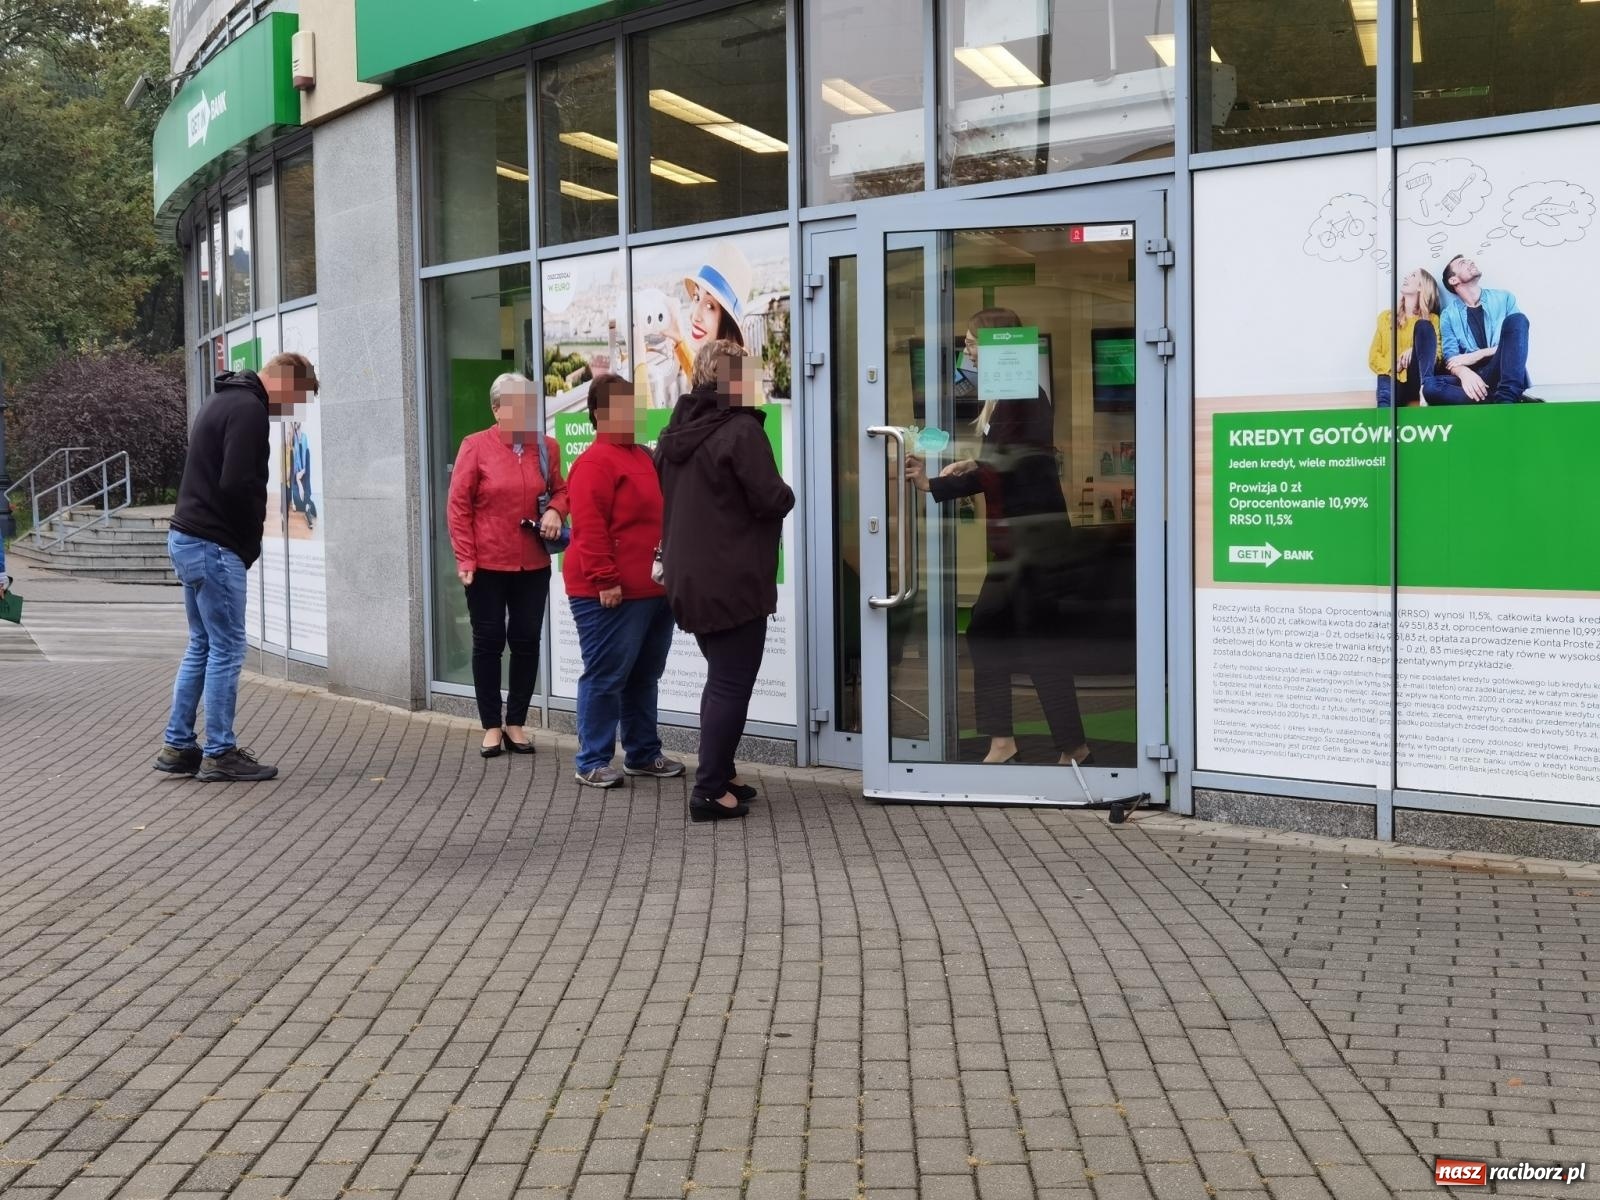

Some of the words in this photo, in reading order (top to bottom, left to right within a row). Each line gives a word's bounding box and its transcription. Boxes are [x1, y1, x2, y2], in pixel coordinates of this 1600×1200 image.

[210, 90, 227, 121] BANK
[554, 282, 571, 292] EURO
[1229, 428, 1305, 447] KREDYT
[1309, 422, 1453, 446] GOTÓWKOWY
[1229, 458, 1258, 469] Jeden
[1260, 458, 1296, 470] kredyt,
[1299, 457, 1326, 468] wiele
[1229, 482, 1278, 496] Prowizja
[1280, 482, 1288, 493] 0
[1290, 481, 1302, 493] zł
[1229, 497, 1326, 511] Oprocentowanie
[1328, 497, 1368, 510] 10,99%
[1229, 514, 1262, 526] RRSO
[1265, 514, 1294, 526] 11,5%
[1237, 550, 1258, 560] GET
[1261, 550, 1272, 560] IN
[1284, 550, 1314, 560] BANK
[1213, 602, 1261, 614] Rzeczywista
[1265, 604, 1294, 614] Roczna
[1298, 605, 1322, 617] Stopa
[1398, 608, 1429, 620] (RRSO)
[1434, 610, 1464, 621] wynosi
[1497, 612, 1542, 622] całkowita
[1546, 613, 1574, 623] kwota
[1213, 613, 1247, 626] kosztów)
[1249, 614, 1260, 624] 34
[1261, 615, 1275, 624] 600
[1288, 616, 1327, 626] całkowita
[1329, 617, 1354, 627] kwota
[1355, 618, 1366, 628] do
[1398, 620, 1409, 629] 49
[1411, 620, 1438, 633] 551,83
[1453, 624, 1528, 634] oprocentowanie
[1530, 625, 1570, 636] zmienne
[1213, 624, 1220, 633] 14
[1222, 624, 1246, 636] 951,83
[1248, 625, 1254, 634] zł
[1256, 625, 1264, 637] (w
[1285, 627, 1319, 639] prowizja
[1326, 628, 1332, 638] 0
[1344, 629, 1374, 639] odsetki
[1429, 633, 1458, 644] opłata
[1472, 635, 1531, 646] prowadzenie
[1534, 637, 1560, 647] Konta
[1563, 638, 1594, 648] Proste
[1213, 636, 1255, 649] debetowej
[1257, 638, 1267, 647] do
[1270, 638, 1293, 648] Konta
[1304, 640, 1334, 650] okresie
[1336, 641, 1365, 651] trwania
[1406, 644, 1412, 653] 0
[1430, 645, 1442, 655] 83
[1444, 646, 1494, 659] miesięczne
[1497, 648, 1514, 660] raty
[1517, 649, 1546, 659] równe
[1213, 647, 1240, 657] została
[1242, 648, 1282, 659] dokonana
[1294, 650, 1316, 660] dzień
[1318, 652, 1358, 662] 13.06.2022
